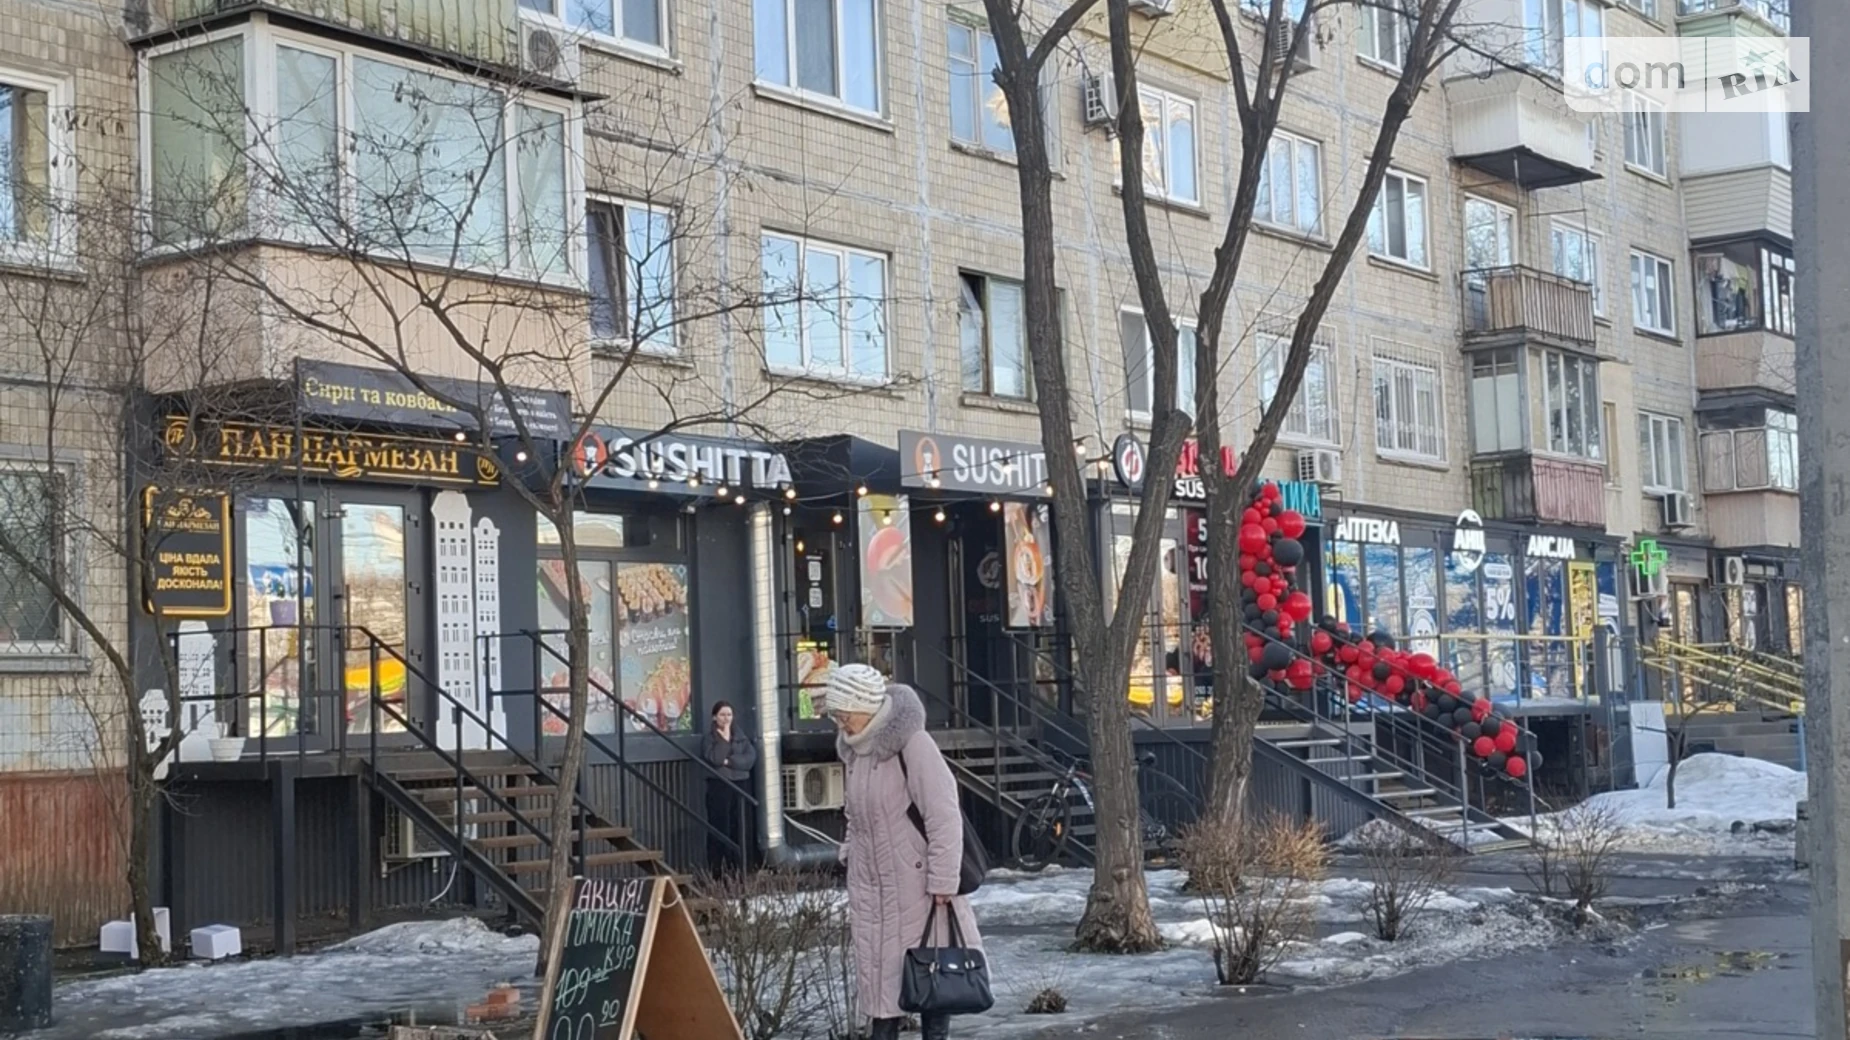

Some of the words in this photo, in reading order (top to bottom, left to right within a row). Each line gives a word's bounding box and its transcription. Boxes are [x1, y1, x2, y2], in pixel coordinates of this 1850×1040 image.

[304, 377, 356, 405] Сири
[360, 387, 381, 403] та
[219, 427, 292, 460] ПАН
[302, 436, 459, 474] ПАРМЕЗАН
[608, 437, 794, 490] SUSHITTA
[952, 443, 1046, 489] SUSHIT
[1175, 480, 1206, 500] SUS
[1334, 515, 1401, 545] АПТЕКА
[1453, 528, 1486, 553] АНЦ
[159, 552, 184, 564] ЦІНА
[185, 553, 220, 565] ВДАЛА
[1527, 534, 1577, 560] ANC.UA
[157, 578, 223, 590] ДОСКОНАЛА!
[172, 565, 208, 577] ЯКІСТЬ
[1486, 587, 1515, 620] 5%
[979, 613, 1001, 623] SUS
[577, 878, 645, 914] АКЦІЯ!
